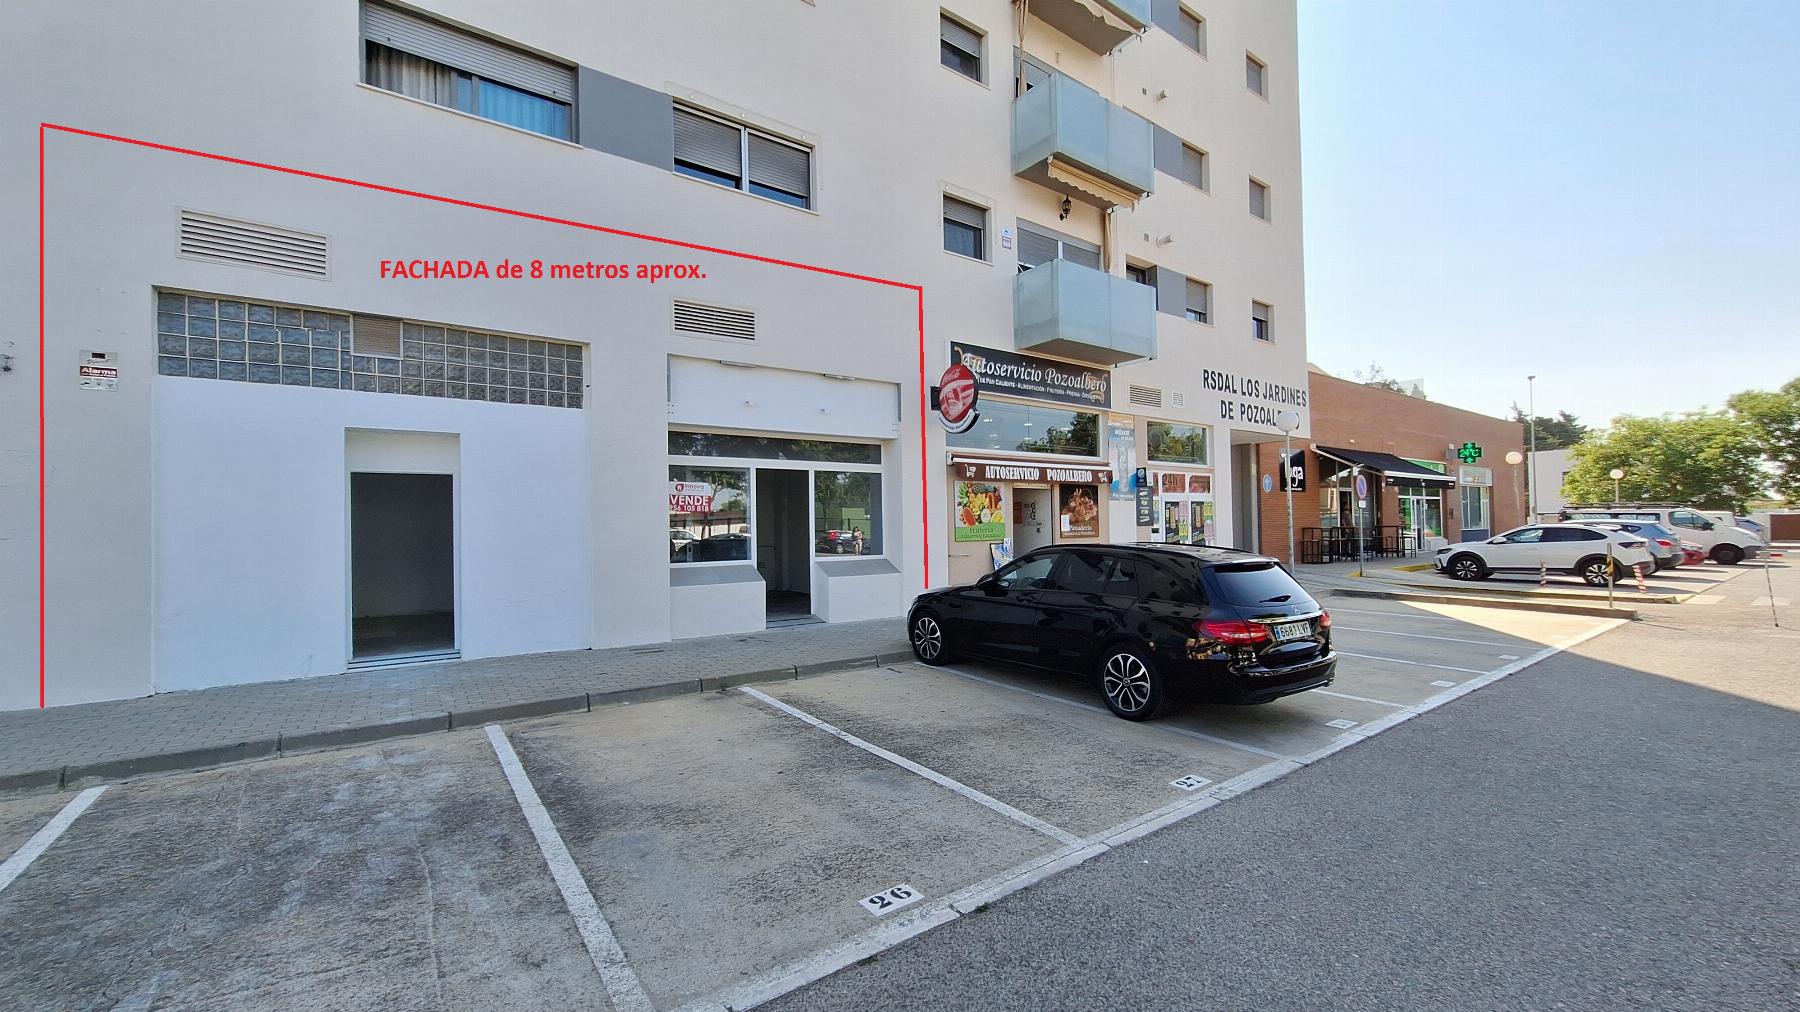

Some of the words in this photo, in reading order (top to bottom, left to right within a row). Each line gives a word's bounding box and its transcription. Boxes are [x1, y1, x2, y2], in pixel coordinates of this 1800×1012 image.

[1045, 368, 1107, 392] Pozoalbero
[1203, 369, 1237, 394] RSDAL
[1240, 377, 1260, 398] LOS
[1262, 382, 1307, 407] JARDINES
[1220, 400, 1234, 420] DE
[1240, 403, 1300, 430] POZOAL
[985, 465, 1040, 481] AUTOSERVICIO
[1047, 469, 1093, 482] POZOALBERO
[670, 495, 709, 505] VENDE
[1175, 776, 1204, 788] 27
[868, 887, 912, 909] 26
